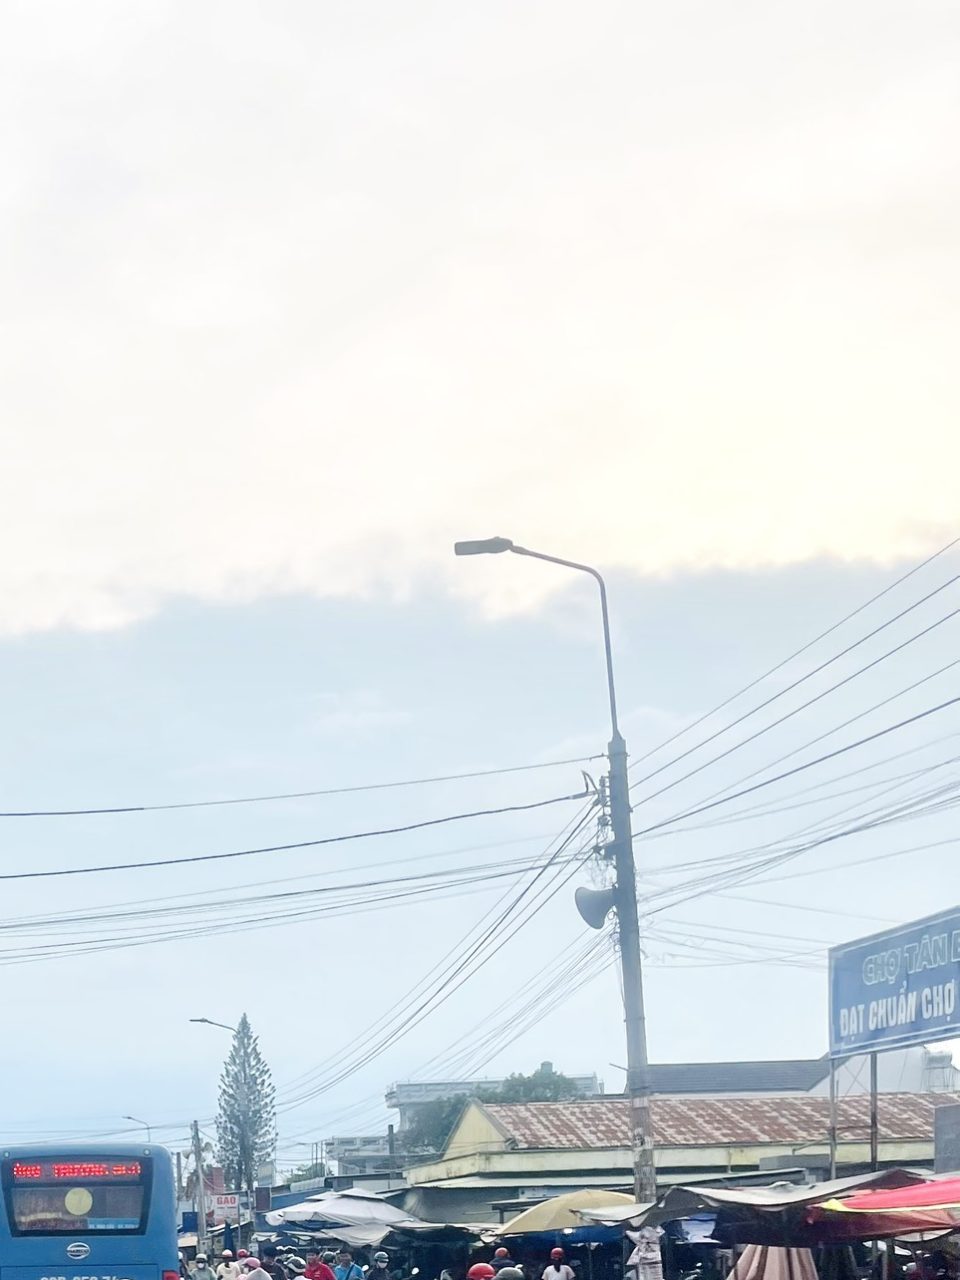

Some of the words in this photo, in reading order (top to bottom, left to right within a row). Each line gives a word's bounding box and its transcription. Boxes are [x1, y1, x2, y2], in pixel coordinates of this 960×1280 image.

[903, 933, 948, 974] TÂN
[839, 1004, 865, 1041] ĐẠT
[869, 980, 917, 1032] CHUẨN
[921, 978, 956, 1022] CHỢ
